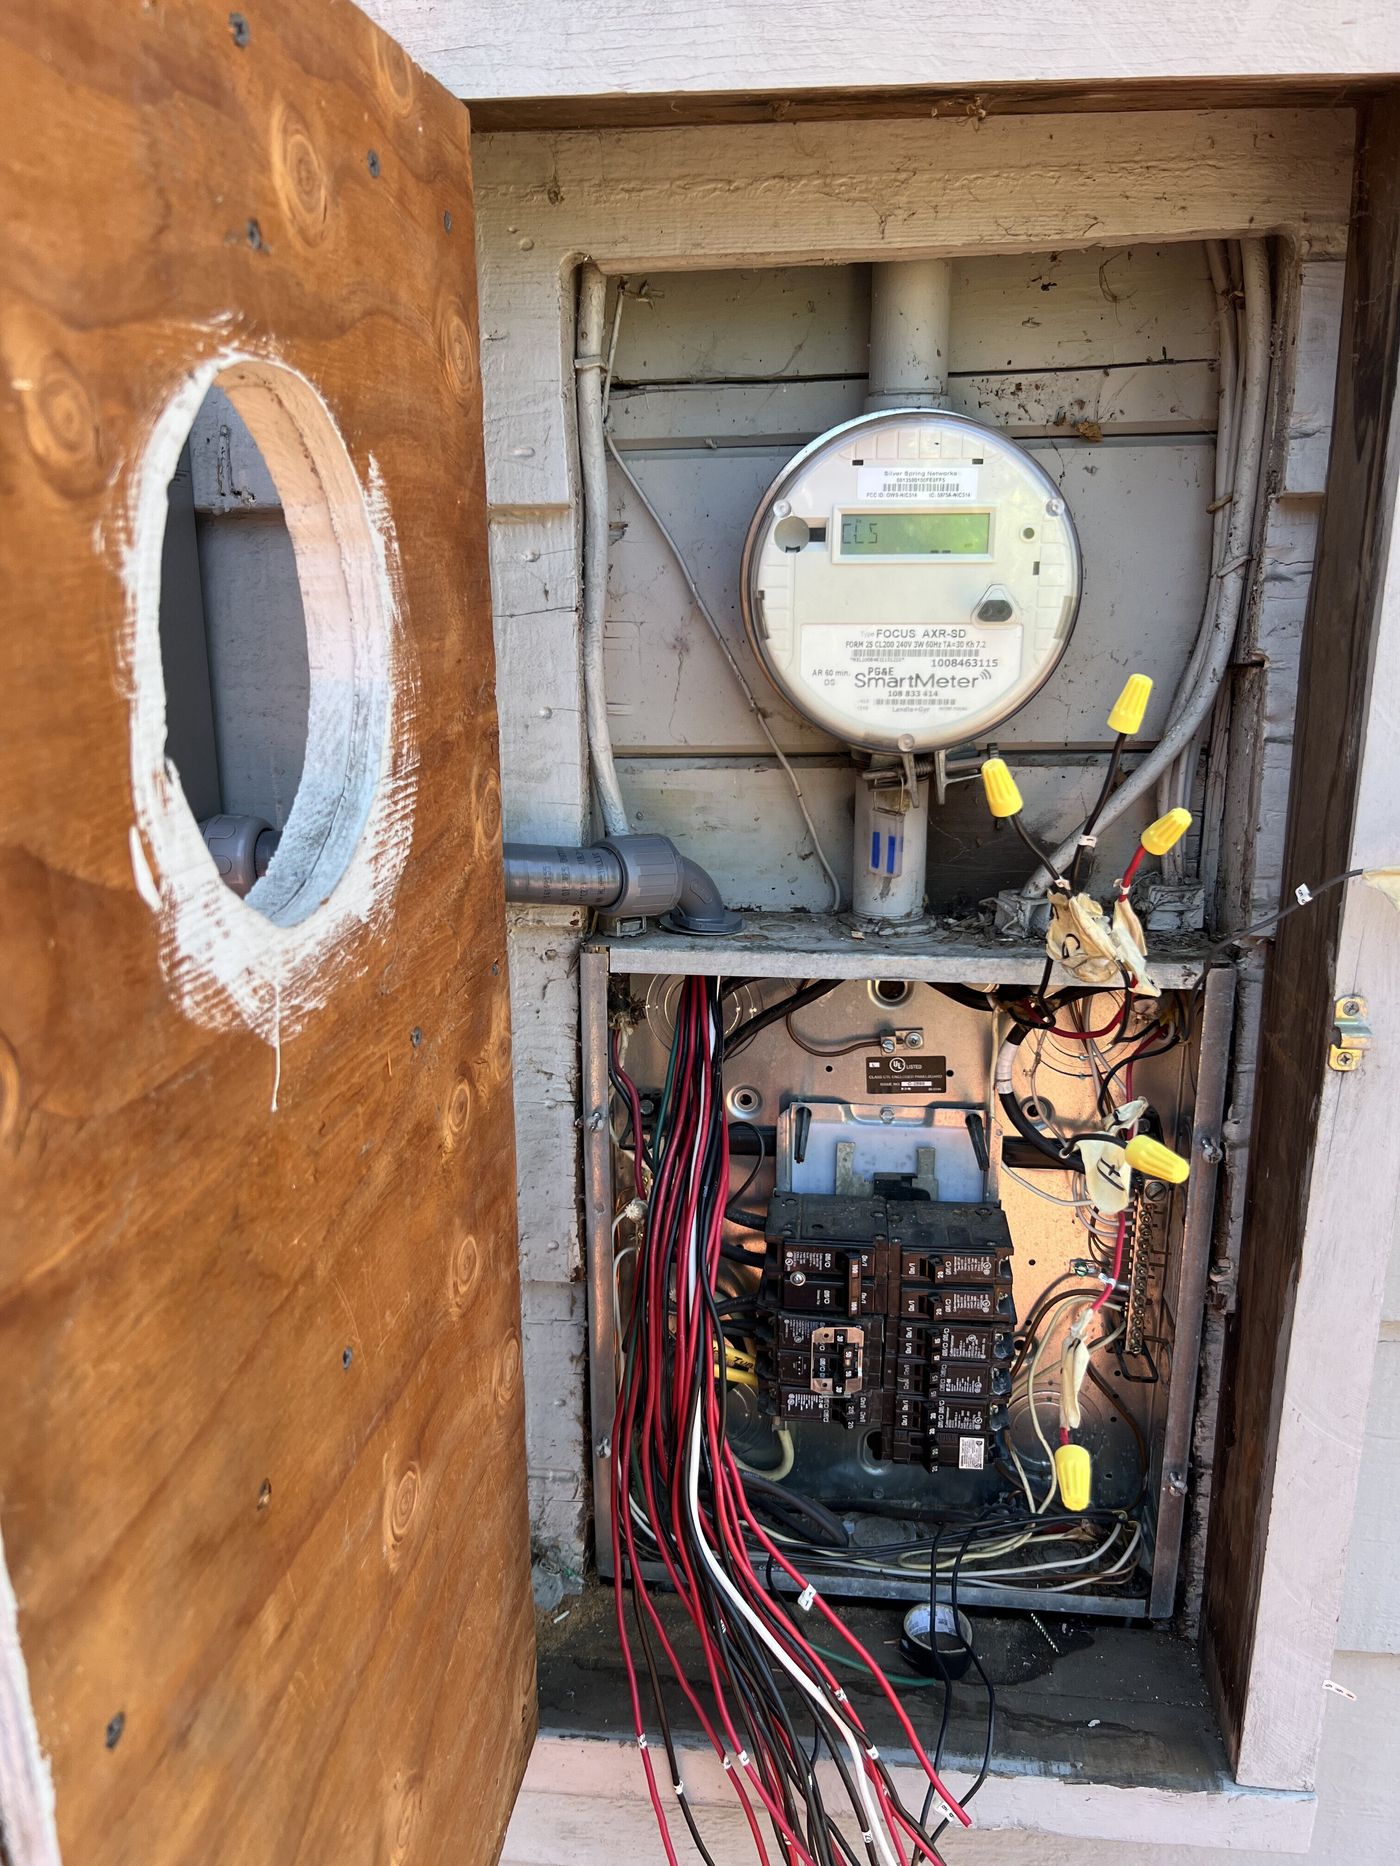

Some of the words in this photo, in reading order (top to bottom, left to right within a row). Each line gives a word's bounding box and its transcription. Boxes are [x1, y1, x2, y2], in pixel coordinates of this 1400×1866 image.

[876, 629, 916, 639] FOCUS
[922, 629, 967, 639] AXR-SD
[845, 641, 864, 649] FORM
[875, 641, 895, 649] CL200
[896, 641, 912, 649] 240V
[976, 640, 986, 648] 7.2
[931, 659, 998, 668] 1008463115
[825, 669, 834, 677] 60
[868, 667, 894, 676] PG&E
[854, 672, 979, 689] SmartMeter
